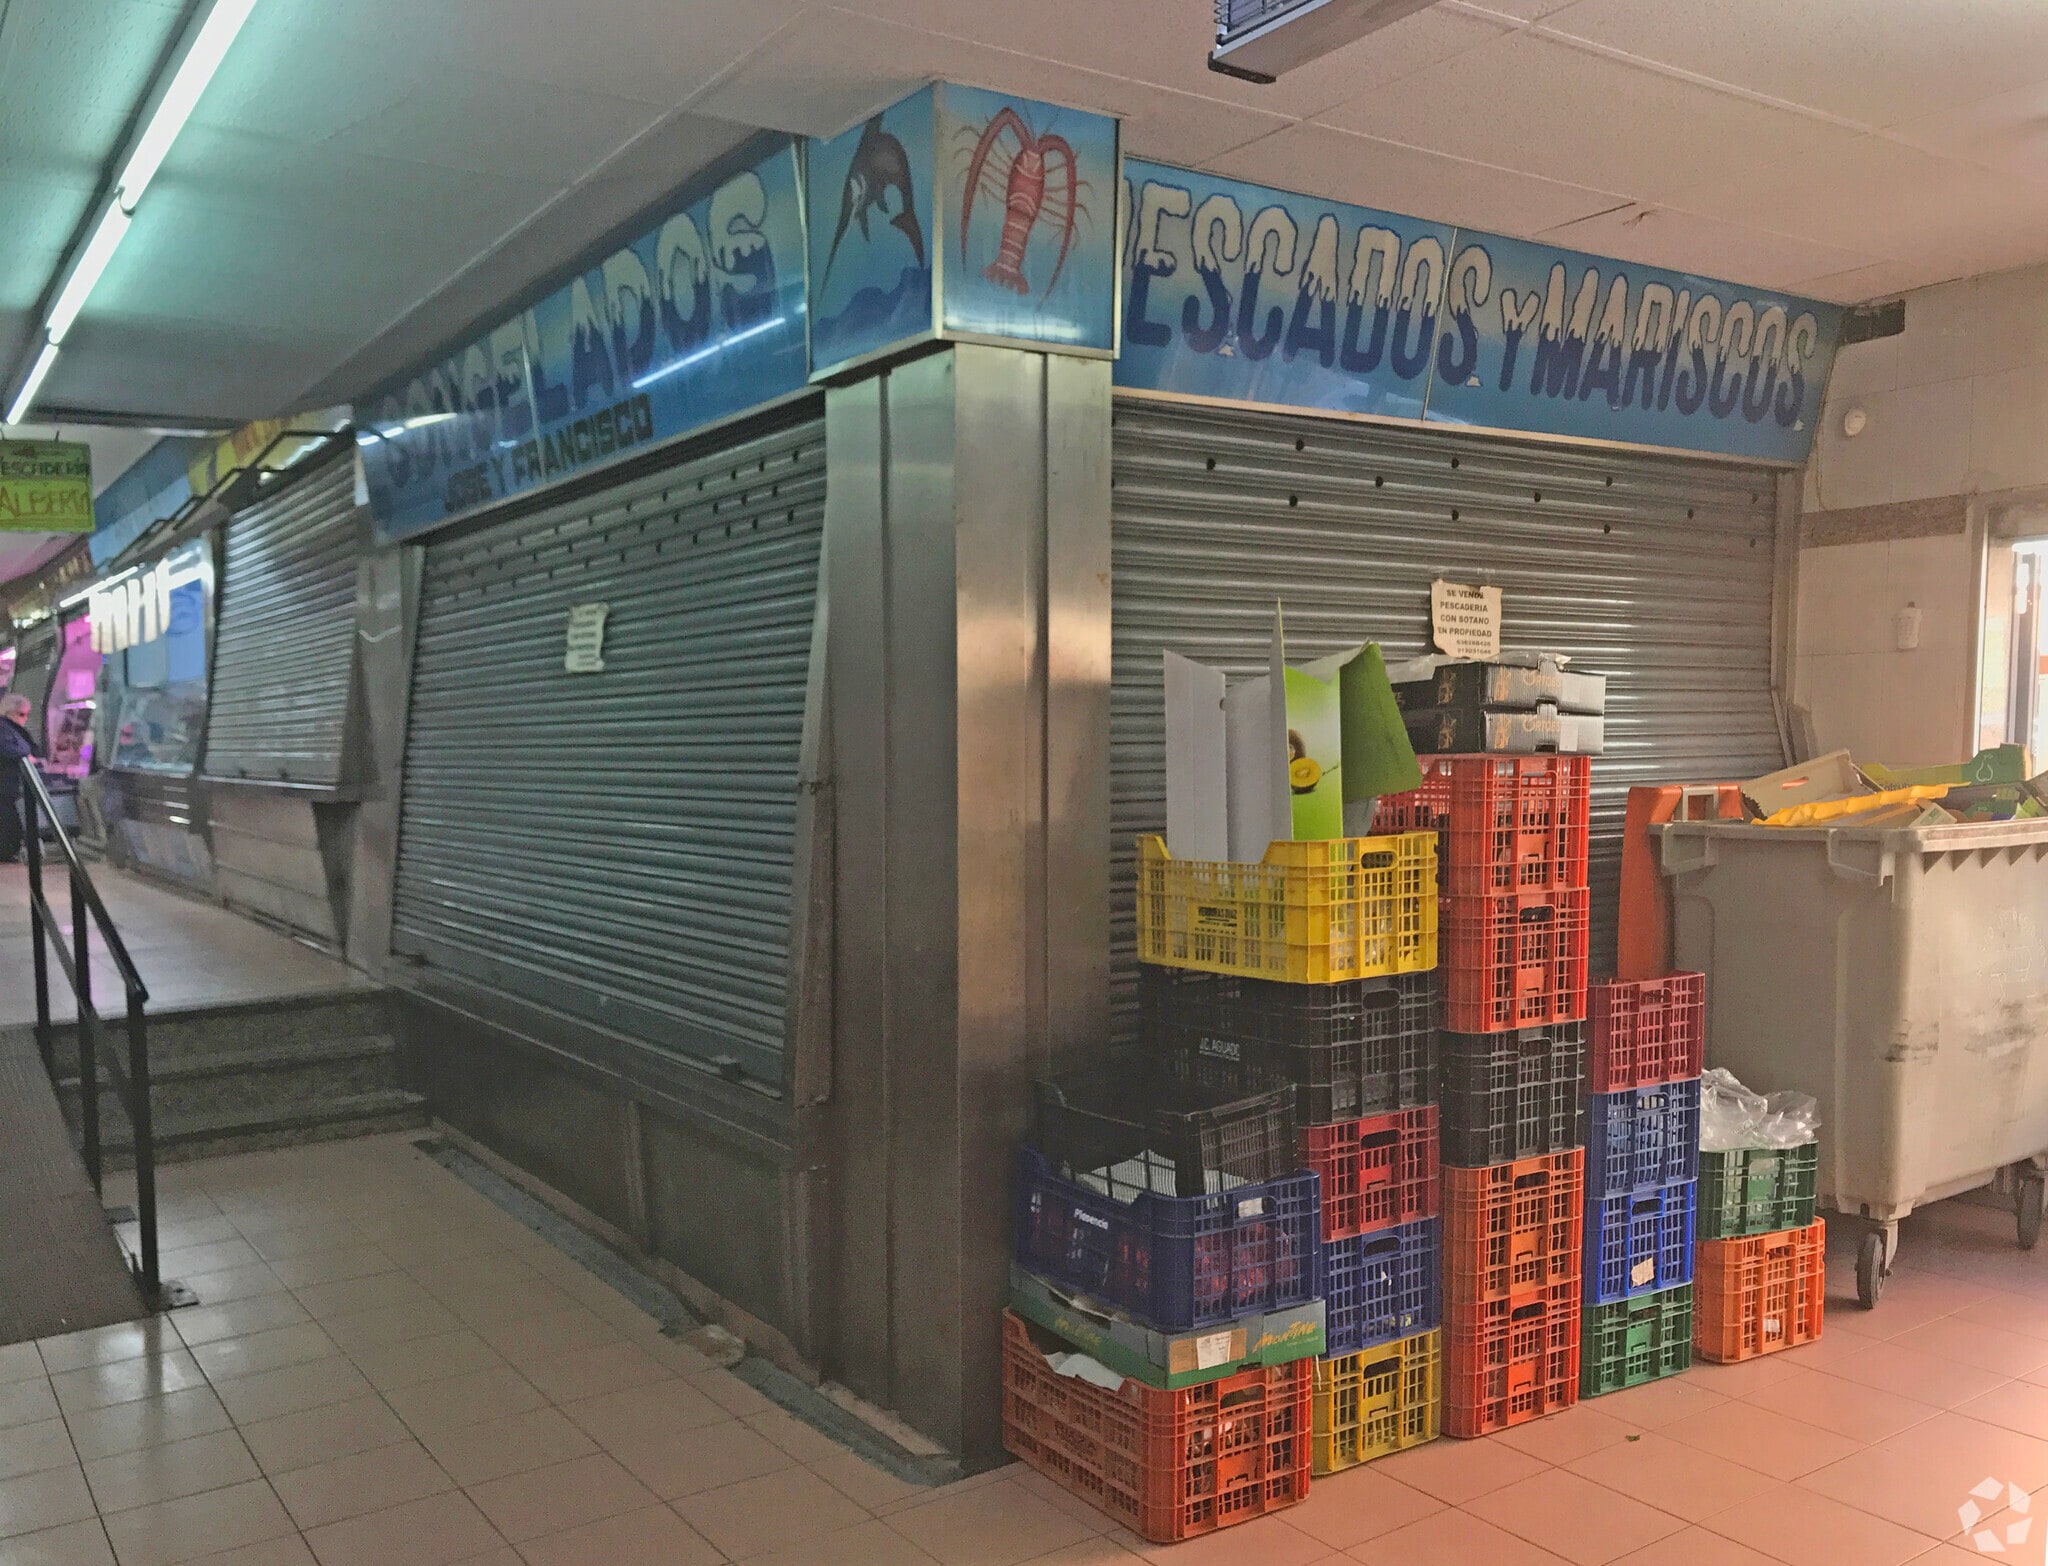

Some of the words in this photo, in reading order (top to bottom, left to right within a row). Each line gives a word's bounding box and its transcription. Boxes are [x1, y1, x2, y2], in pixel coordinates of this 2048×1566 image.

[1500, 288, 1541, 392] Y
[1530, 261, 1819, 427] MARISCOS
[511, 392, 653, 486] FRANCISCO
[1446, 589, 1456, 597] SE
[1439, 601, 1488, 612] PESCADERIA
[1440, 614, 1457, 622] CON
[1459, 615, 1490, 625] SOTANO
[1438, 626, 1447, 634] EN
[1449, 627, 1492, 637] PROPIEDAD
